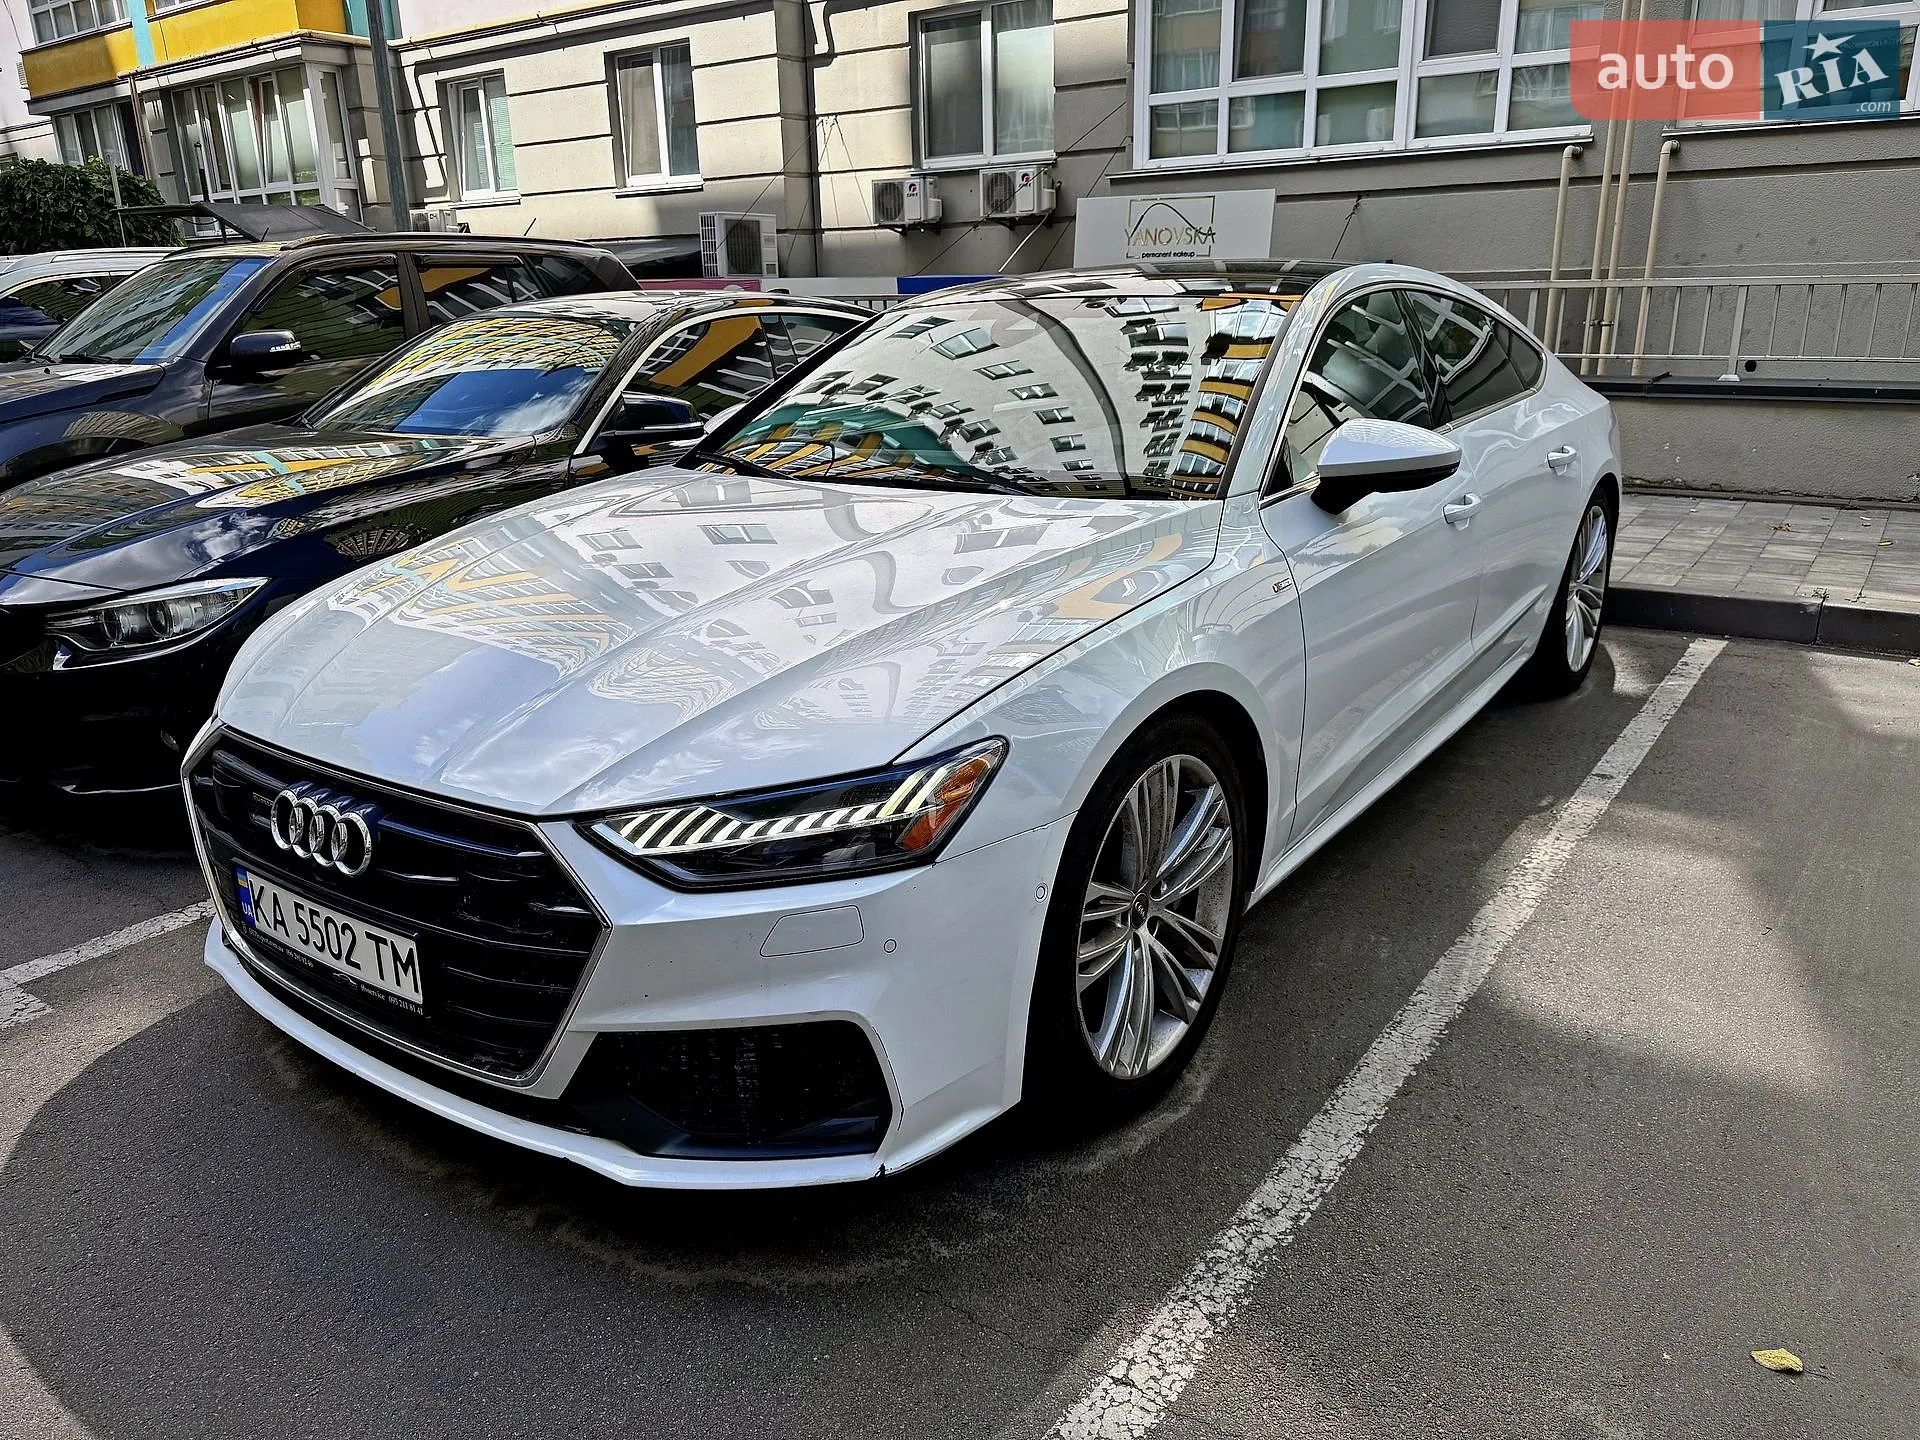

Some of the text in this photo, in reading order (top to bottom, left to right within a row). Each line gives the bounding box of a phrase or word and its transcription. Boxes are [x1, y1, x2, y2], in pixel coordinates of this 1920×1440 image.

[1124, 226, 1216, 246] YANOVSKA
[249, 879, 290, 939] KA
[293, 900, 361, 971] 5502
[364, 930, 420, 994] TM
